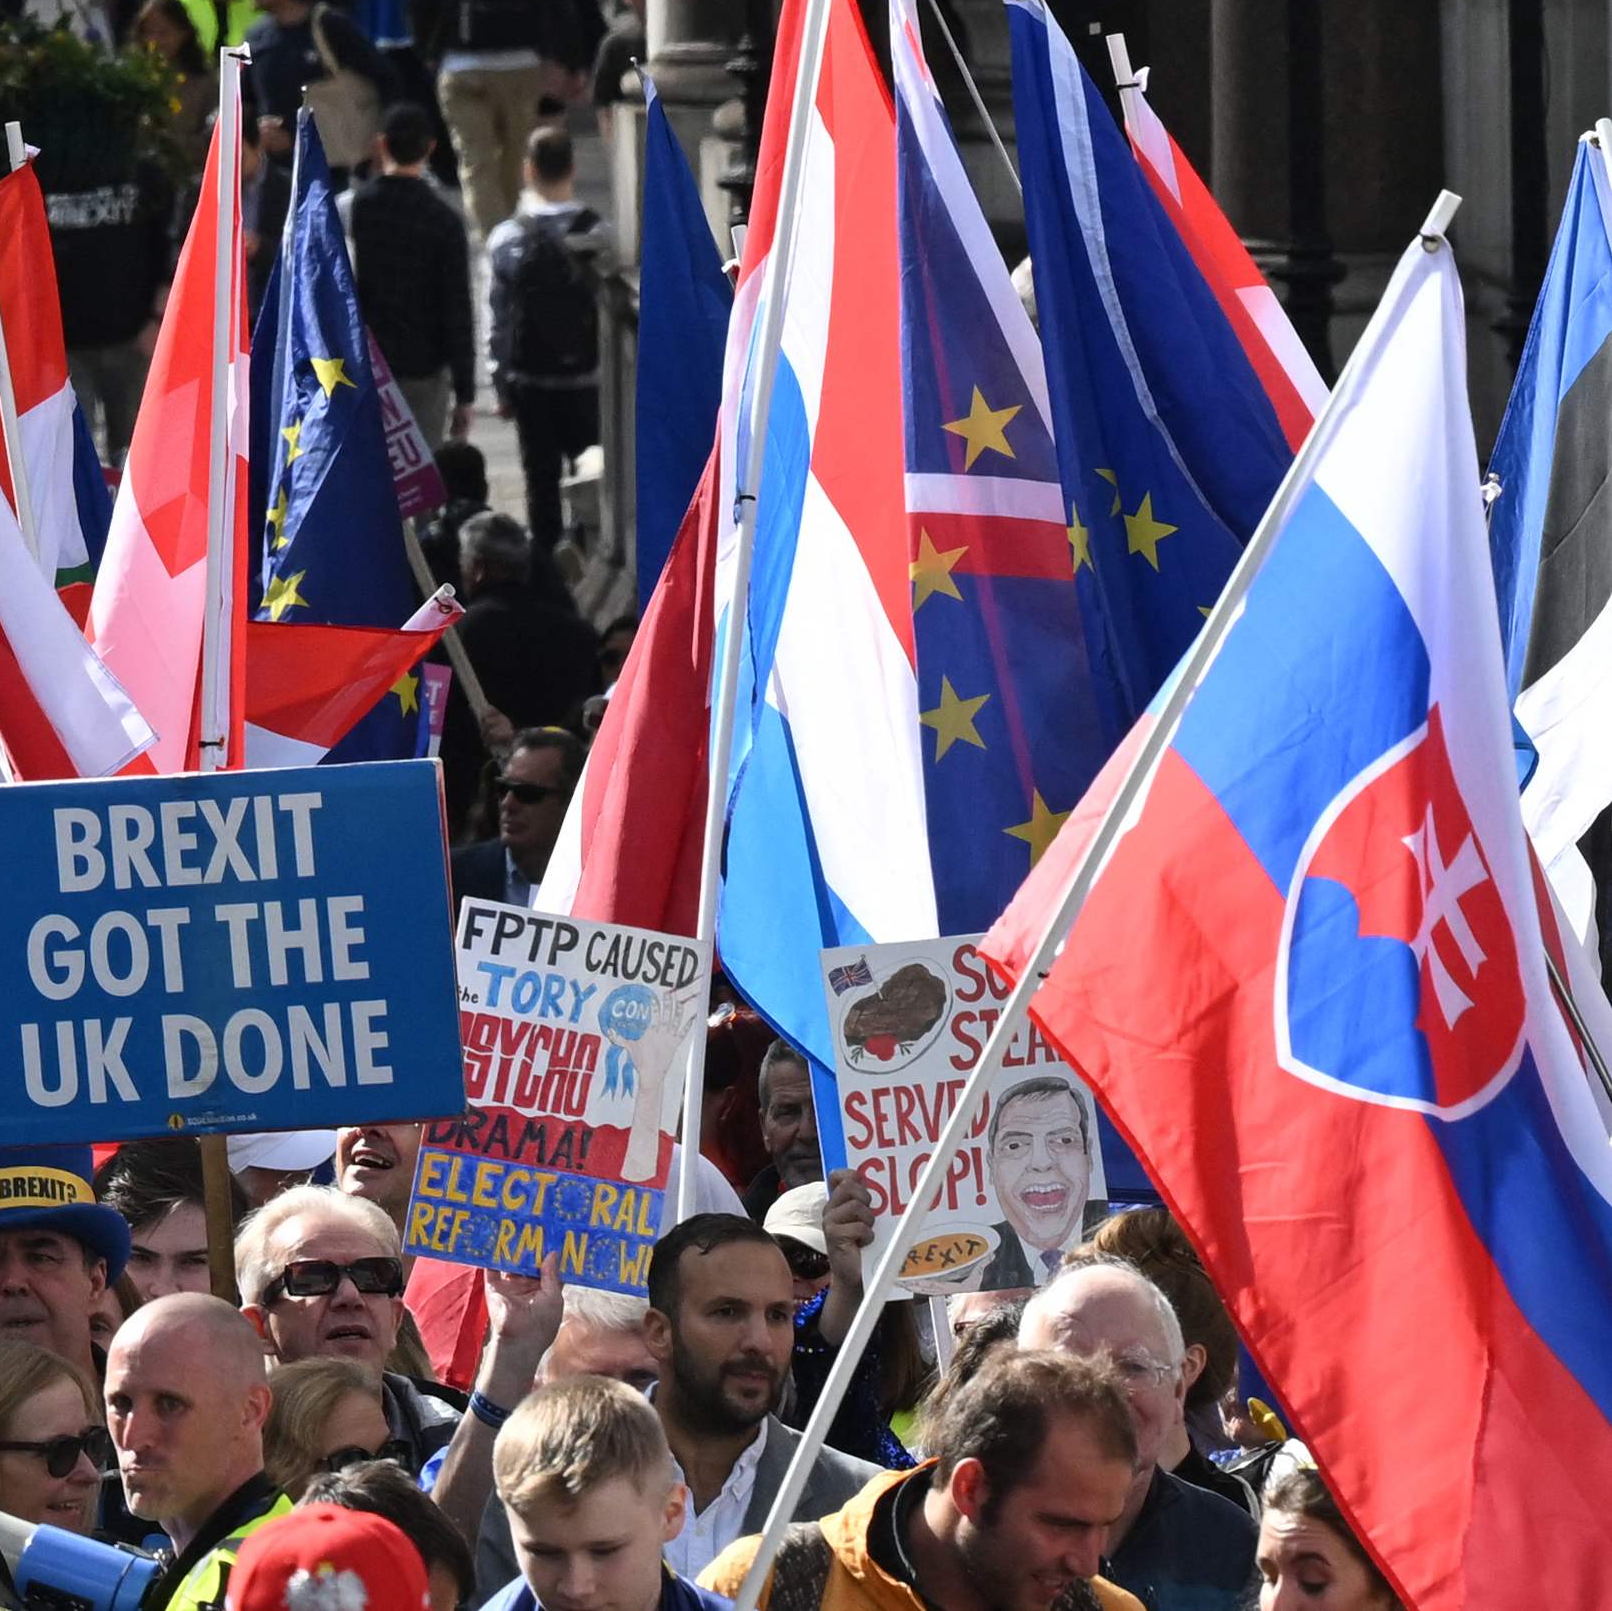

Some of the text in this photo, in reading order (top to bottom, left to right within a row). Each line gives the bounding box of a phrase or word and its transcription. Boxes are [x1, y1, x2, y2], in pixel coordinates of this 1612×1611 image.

[53, 792, 323, 893] BREXIT
[26, 895, 371, 1001] GOT THE
[462, 907, 701, 989] FPTP CAUSED
[476, 961, 599, 1023] TORY
[20, 999, 394, 1108] UK DONE
[949, 1008, 1069, 1071] STEA
[428, 1113, 594, 1170] DRAMA!
[419, 1151, 656, 1237] ELECTORAL
[857, 1146, 988, 1217] SLOP!
[408, 1202, 546, 1269] REFORM
[901, 1239, 983, 1274] REXIT
